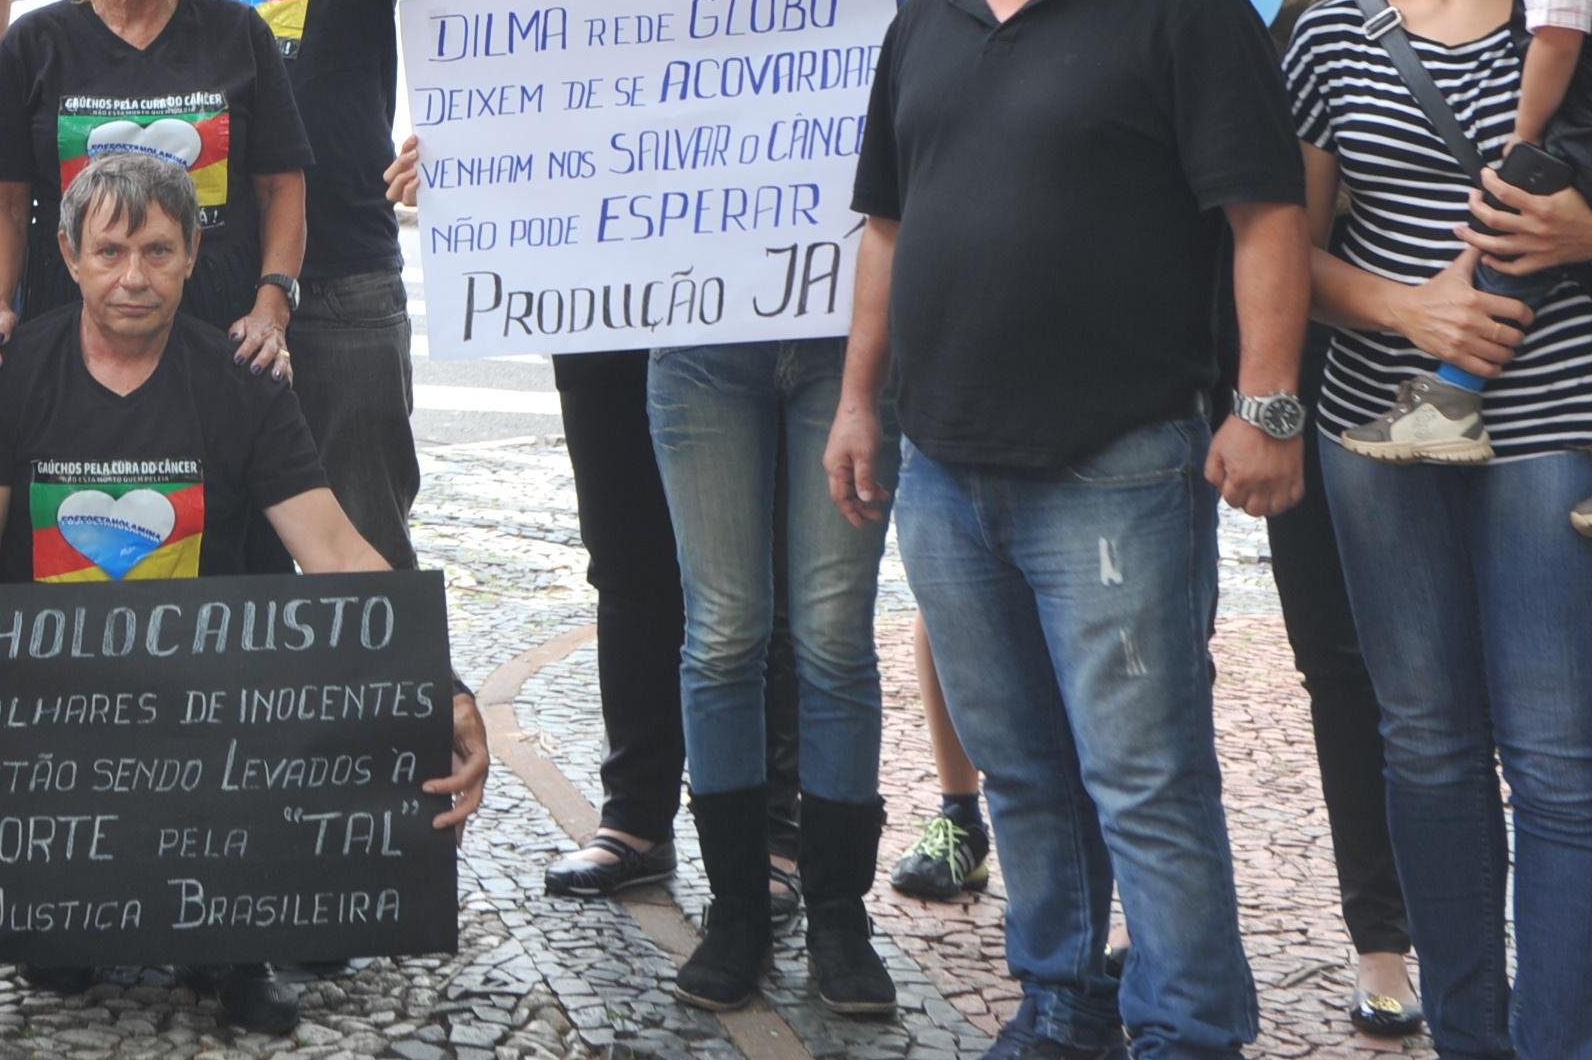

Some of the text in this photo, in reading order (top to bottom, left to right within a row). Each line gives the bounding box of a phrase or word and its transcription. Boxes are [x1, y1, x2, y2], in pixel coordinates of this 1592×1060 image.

[429, 7, 567, 62] DILMA
[584, 13, 675, 47] REDE
[114, 98, 139, 109] PELA
[415, 83, 543, 127] DEIXEM
[563, 78, 604, 111] DE
[614, 77, 645, 108] SE
[421, 154, 533, 189] VENHAM
[548, 150, 596, 181] NOS
[609, 125, 731, 174] SALVAR
[767, 113, 868, 163] CÂNCE
[430, 183, 821, 255] NÃO PODE ESPERAR
[462, 216, 868, 343] PRODUÇÃO JÁ
[37, 458, 197, 474] GAÚCHOS PELA CURA DO CÂNCER
[180, 690, 223, 725] DE
[240, 681, 434, 725] INOCENTES
[92, 756, 202, 792] SENDO
[222, 739, 371, 791] LEVADOS
[159, 827, 248, 859] PELA
[167, 879, 400, 930] BRASILEIRA
